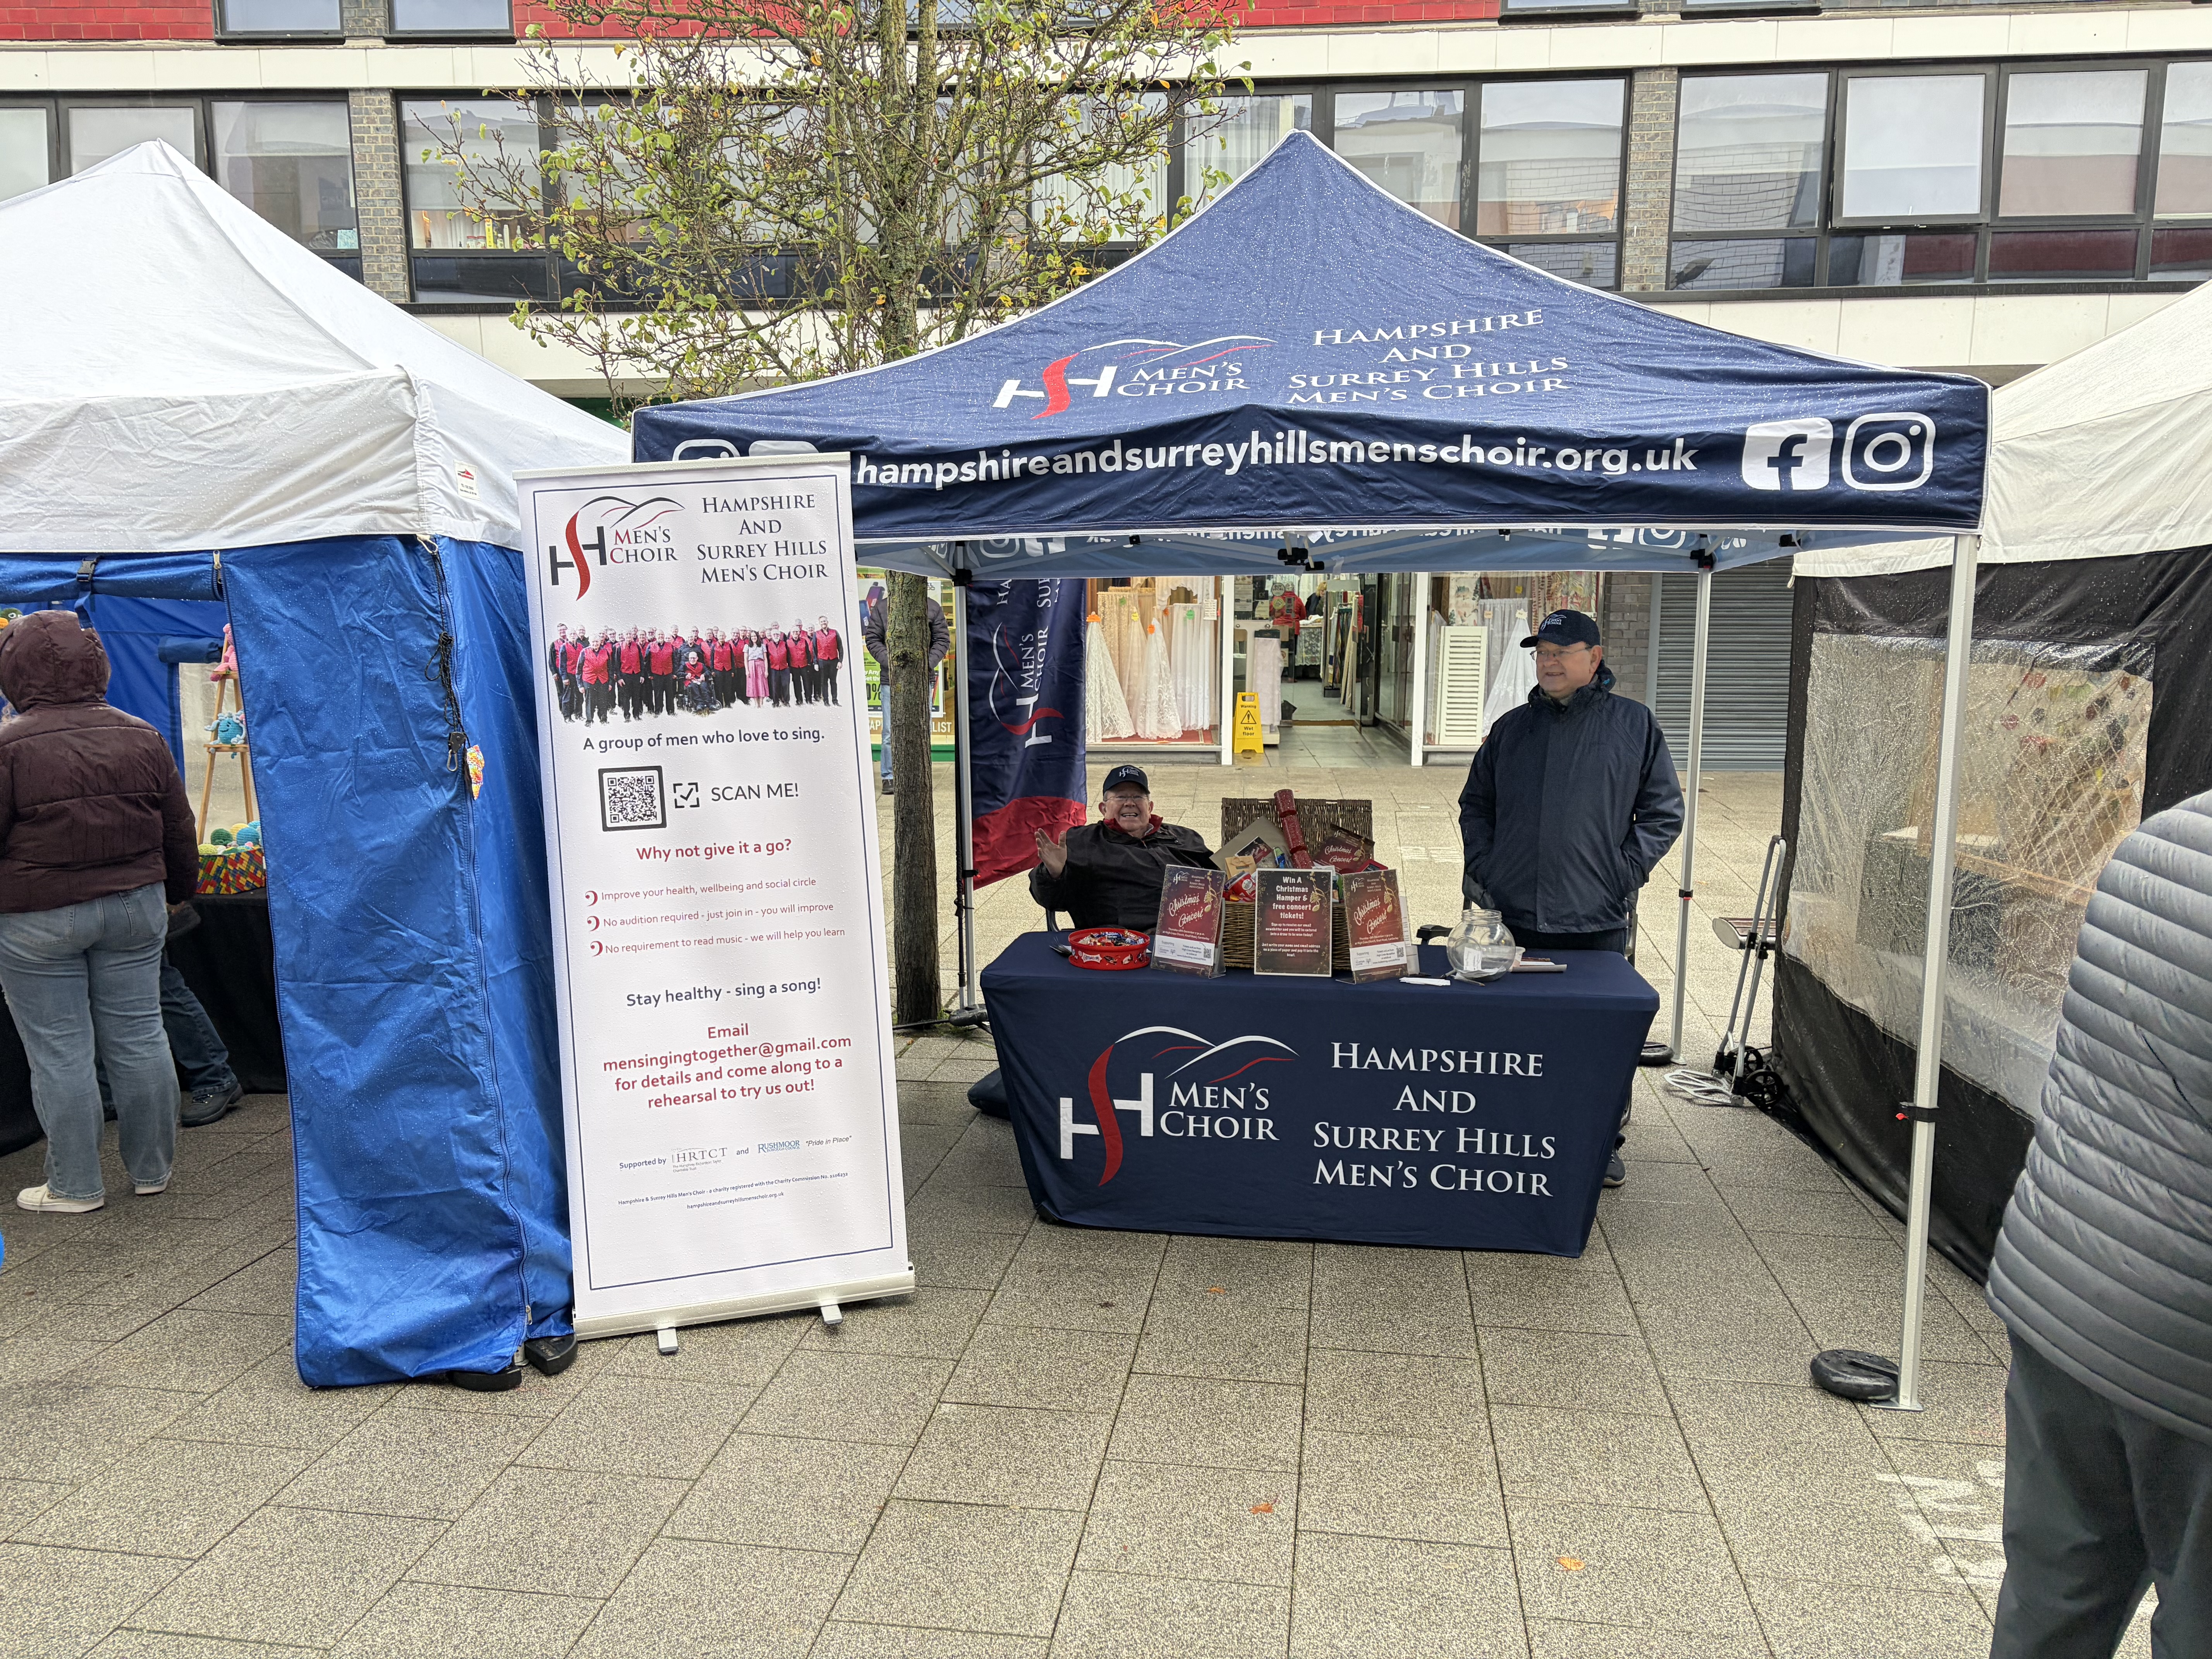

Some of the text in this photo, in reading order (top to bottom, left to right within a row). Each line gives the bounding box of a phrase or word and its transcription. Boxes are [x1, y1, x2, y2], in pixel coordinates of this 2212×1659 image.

[1313, 309, 1544, 345] HAMPSHIRE
[1378, 344, 1472, 363] AND
[1132, 362, 1242, 382] MEN'S
[1289, 357, 1568, 388] SURREY HILLS
[1117, 379, 1250, 397] CHOIR
[1286, 378, 1572, 404] MEN'S CHOIR
[857, 429, 1699, 491] hampshireandsurreyhillsmenschoir.org.uk
[701, 494, 815, 513] HAMPSHIRE
[614, 526, 671, 546] MEN'S
[738, 519, 781, 535] AND
[610, 546, 678, 564] CHOIR
[697, 540, 826, 560] SURREY HILLS
[701, 564, 829, 583] MEN'S CHOIR
[1035, 626, 1049, 692] CHOIR
[932, 722, 951, 733] LIST
[583, 726, 824, 753] A group of men who love to sing.
[711, 783, 799, 802] SCAN ME!
[636, 838, 792, 862] Why not give it a go?
[1325, 845, 1352, 855] Christmas
[601, 877, 816, 902] Improve your health, wellbeing and social circle
[1276, 894, 1301, 902] Hamper
[603, 904, 833, 927] No audition required just join in you will improve
[1169, 895, 1200, 916] Christmas
[1354, 898, 1381, 926] Christmas
[1178, 908, 1204, 927] Concert
[1367, 910, 1387, 934] Concert
[605, 945, 619, 953] No
[622, 939, 679, 953] requirement
[694, 936, 714, 946] read
[766, 931, 781, 941] will
[784, 929, 803, 941] help
[805, 931, 821, 939] you
[824, 927, 845, 936] learn
[627, 977, 821, 1008] Stay healthy sing a song!
[708, 1023, 749, 1039] Email
[603, 1036, 852, 1072] mensingingtogether@gmail.com
[1331, 1042, 1543, 1077] HAMPSHIRE
[615, 1059, 842, 1091] for details and come along to a
[648, 1079, 814, 1108] rehearsal to try us out!
[1168, 1081, 1269, 1110] MEN'S
[1393, 1085, 1476, 1113] AND
[1160, 1111, 1280, 1140] CHOIR
[736, 1147, 749, 1155] and
[757, 1140, 800, 1154] RUSHMOOR
[1314, 1121, 1555, 1159] SURREY HILLS
[619, 1158, 656, 1170] Supported
[677, 1147, 728, 1163] HRTCT
[730, 1182, 754, 1191] registered
[1313, 1159, 1553, 1197] MEN'S CHOIR
